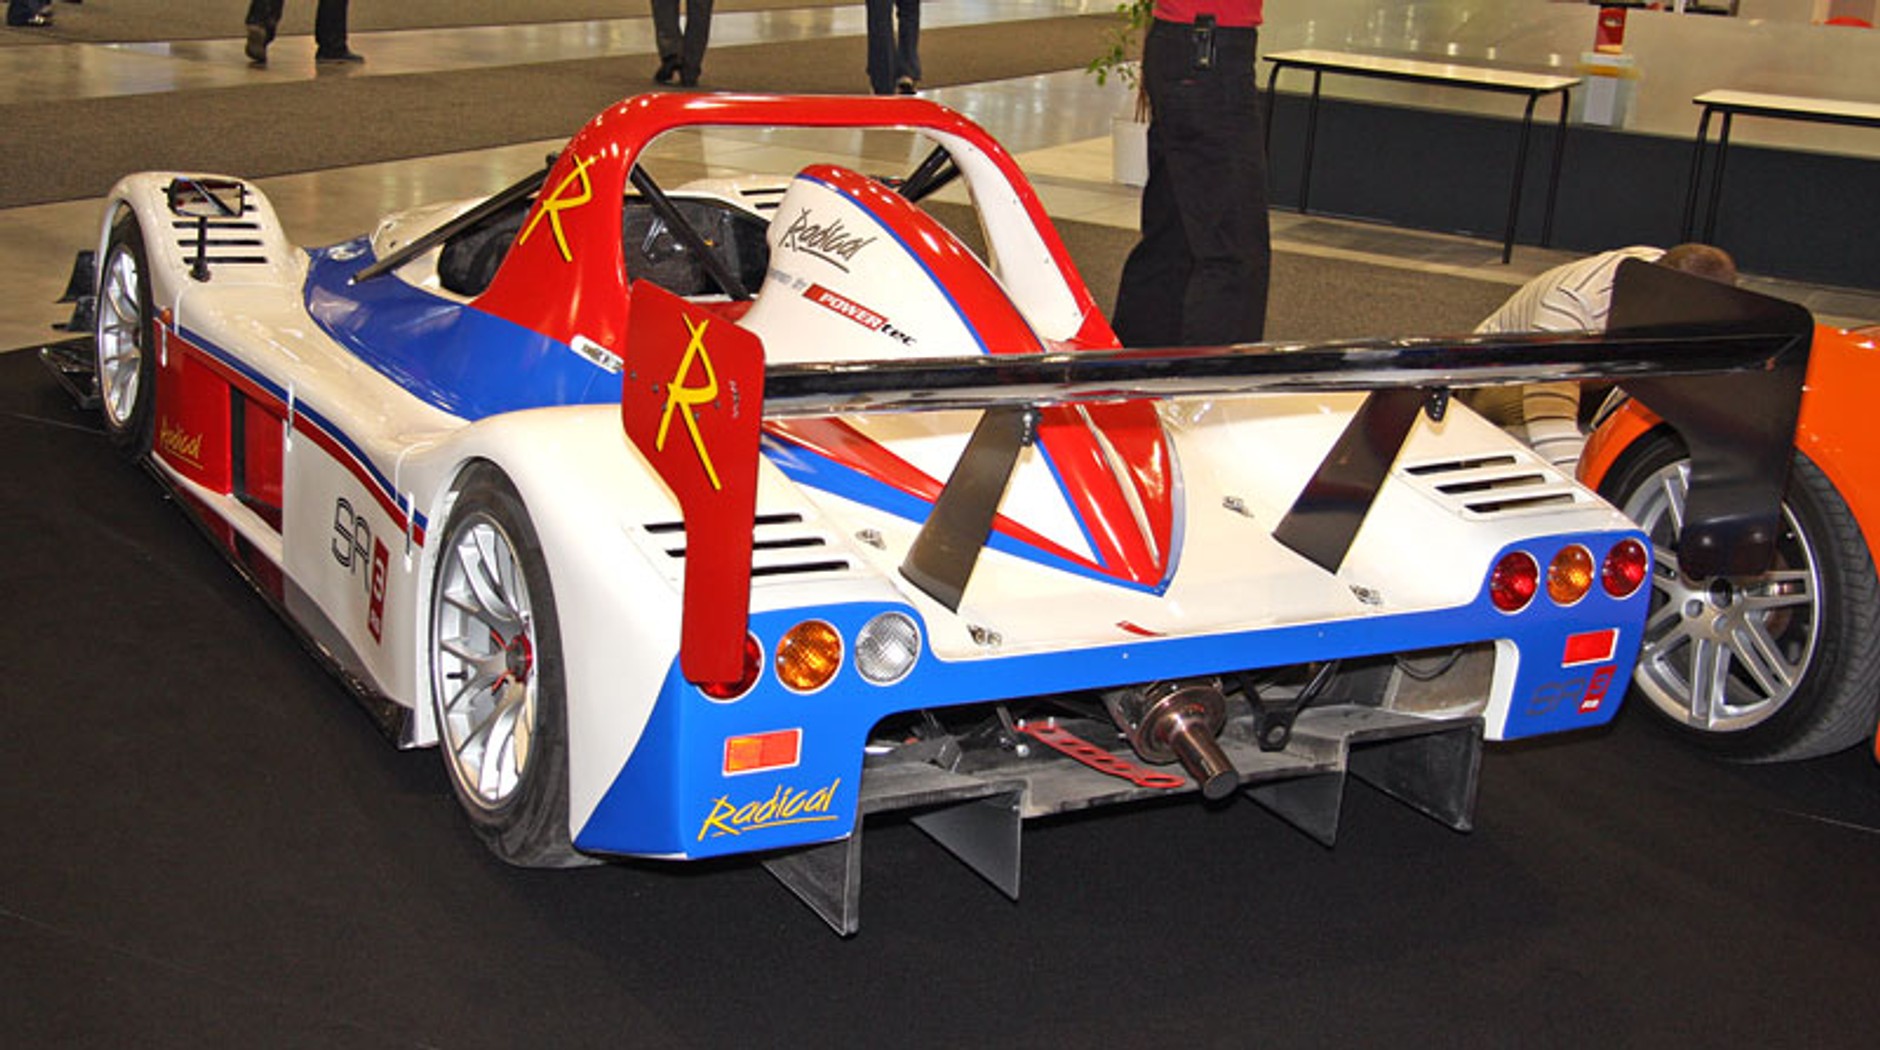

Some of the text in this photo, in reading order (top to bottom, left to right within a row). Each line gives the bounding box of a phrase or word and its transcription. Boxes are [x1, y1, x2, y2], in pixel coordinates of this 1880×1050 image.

[778, 207, 877, 264] Radical
[656, 313, 722, 490] R
[697, 777, 841, 842] Radical
